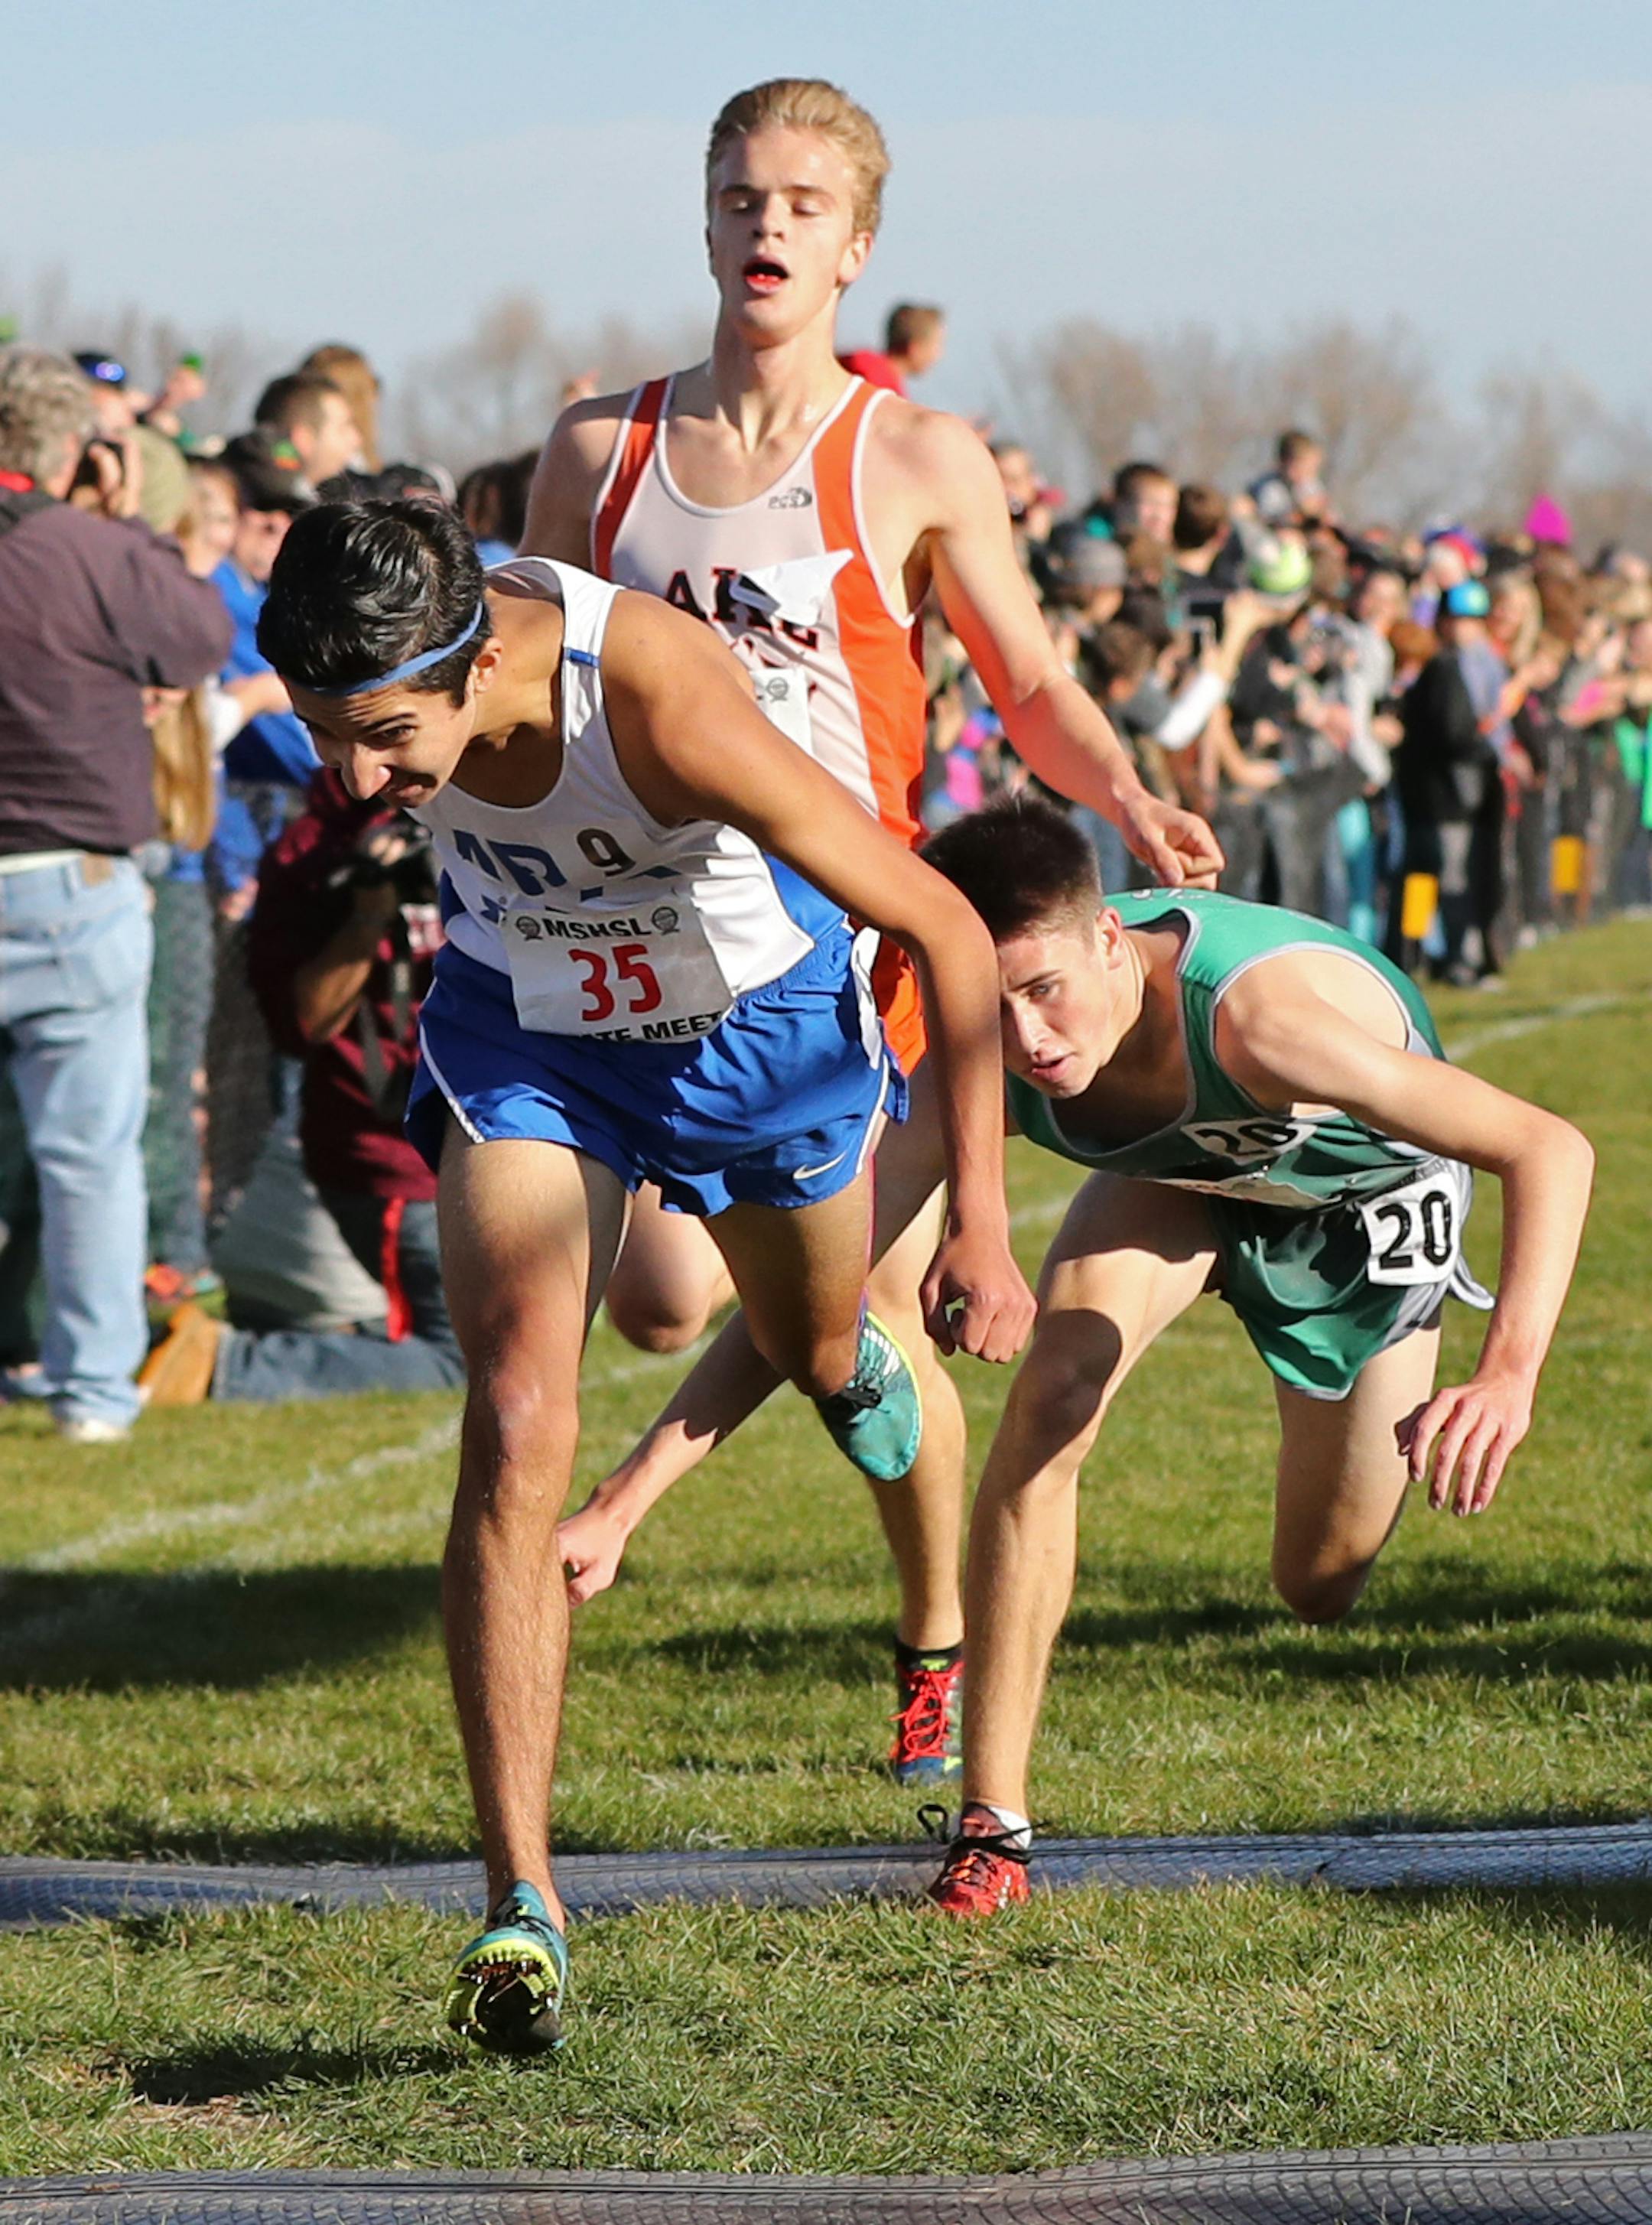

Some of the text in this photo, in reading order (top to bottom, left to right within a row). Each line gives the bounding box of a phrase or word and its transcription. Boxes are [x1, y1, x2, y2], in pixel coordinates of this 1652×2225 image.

[576, 828, 636, 877] 9
[543, 918, 652, 939] MSHSL
[567, 943, 662, 1022] 35
[641, 1011, 722, 1040] MEET
[1194, 1123, 1298, 1156] 20
[1374, 1190, 1452, 1270] 20
